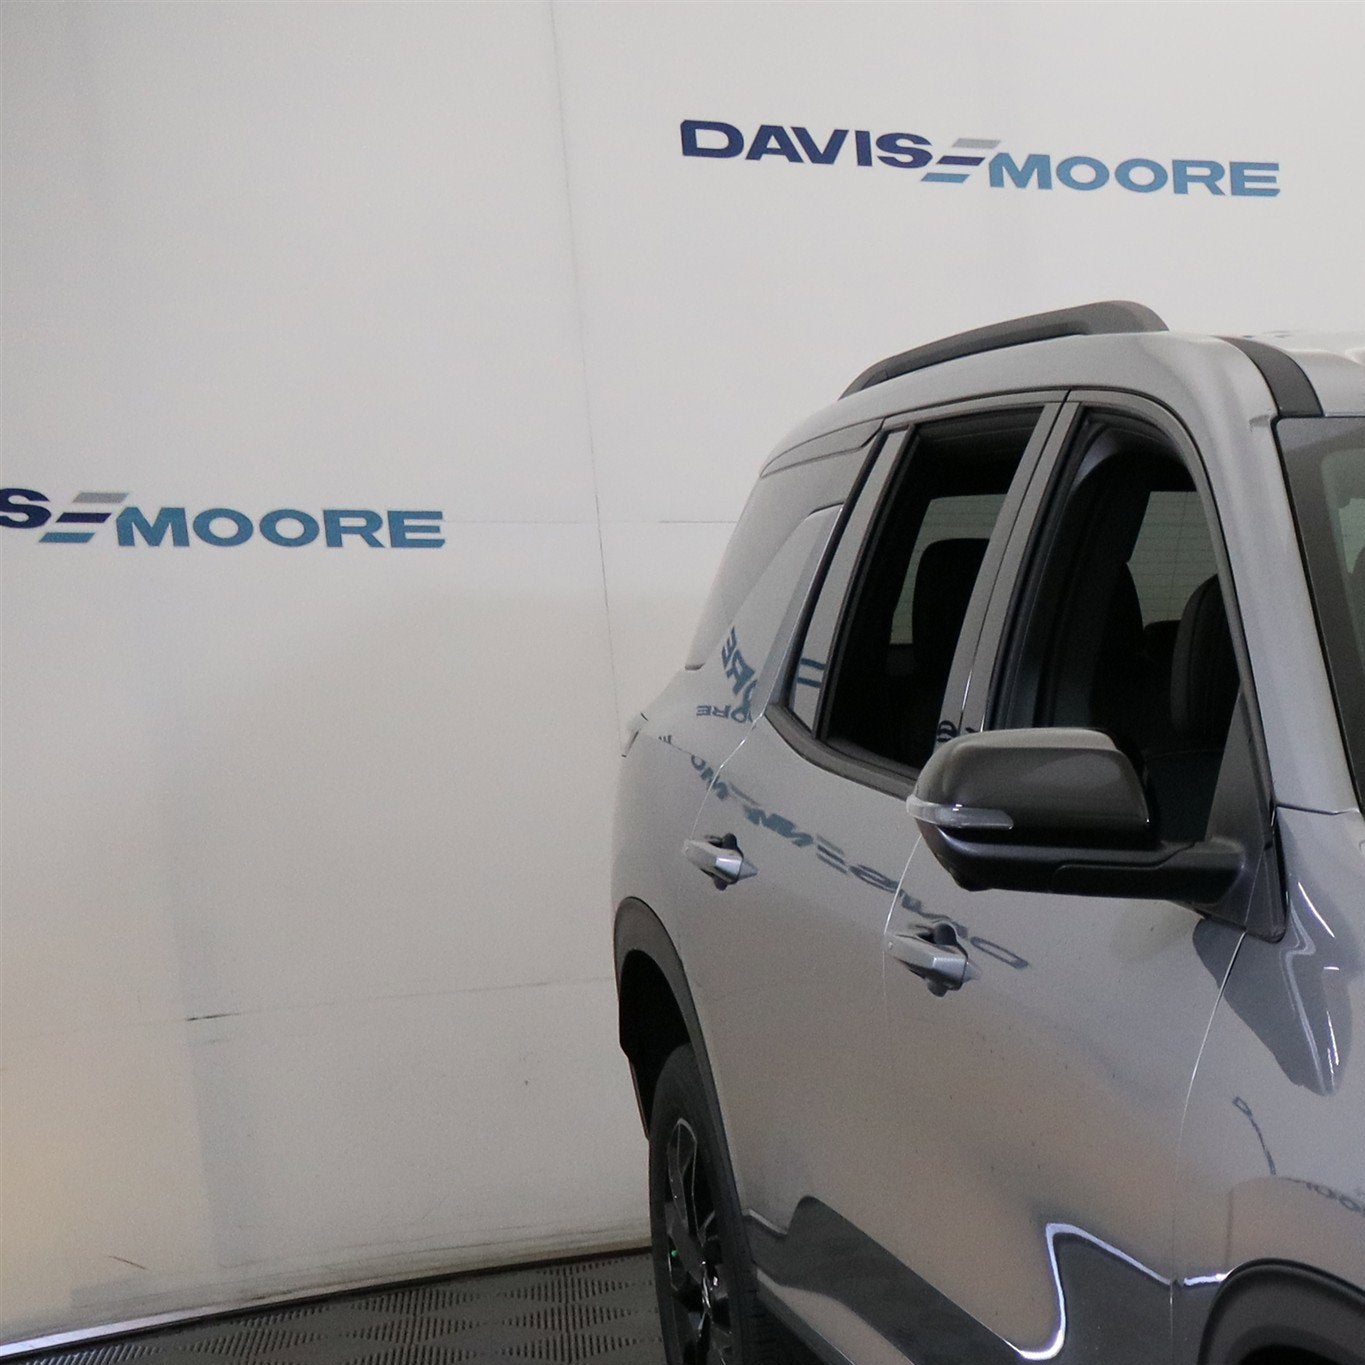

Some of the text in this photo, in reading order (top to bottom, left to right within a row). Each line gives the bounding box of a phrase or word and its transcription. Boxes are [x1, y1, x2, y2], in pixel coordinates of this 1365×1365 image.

[680, 119, 1281, 197] DAVIS MOORE
[115, 506, 446, 548] MOORE
